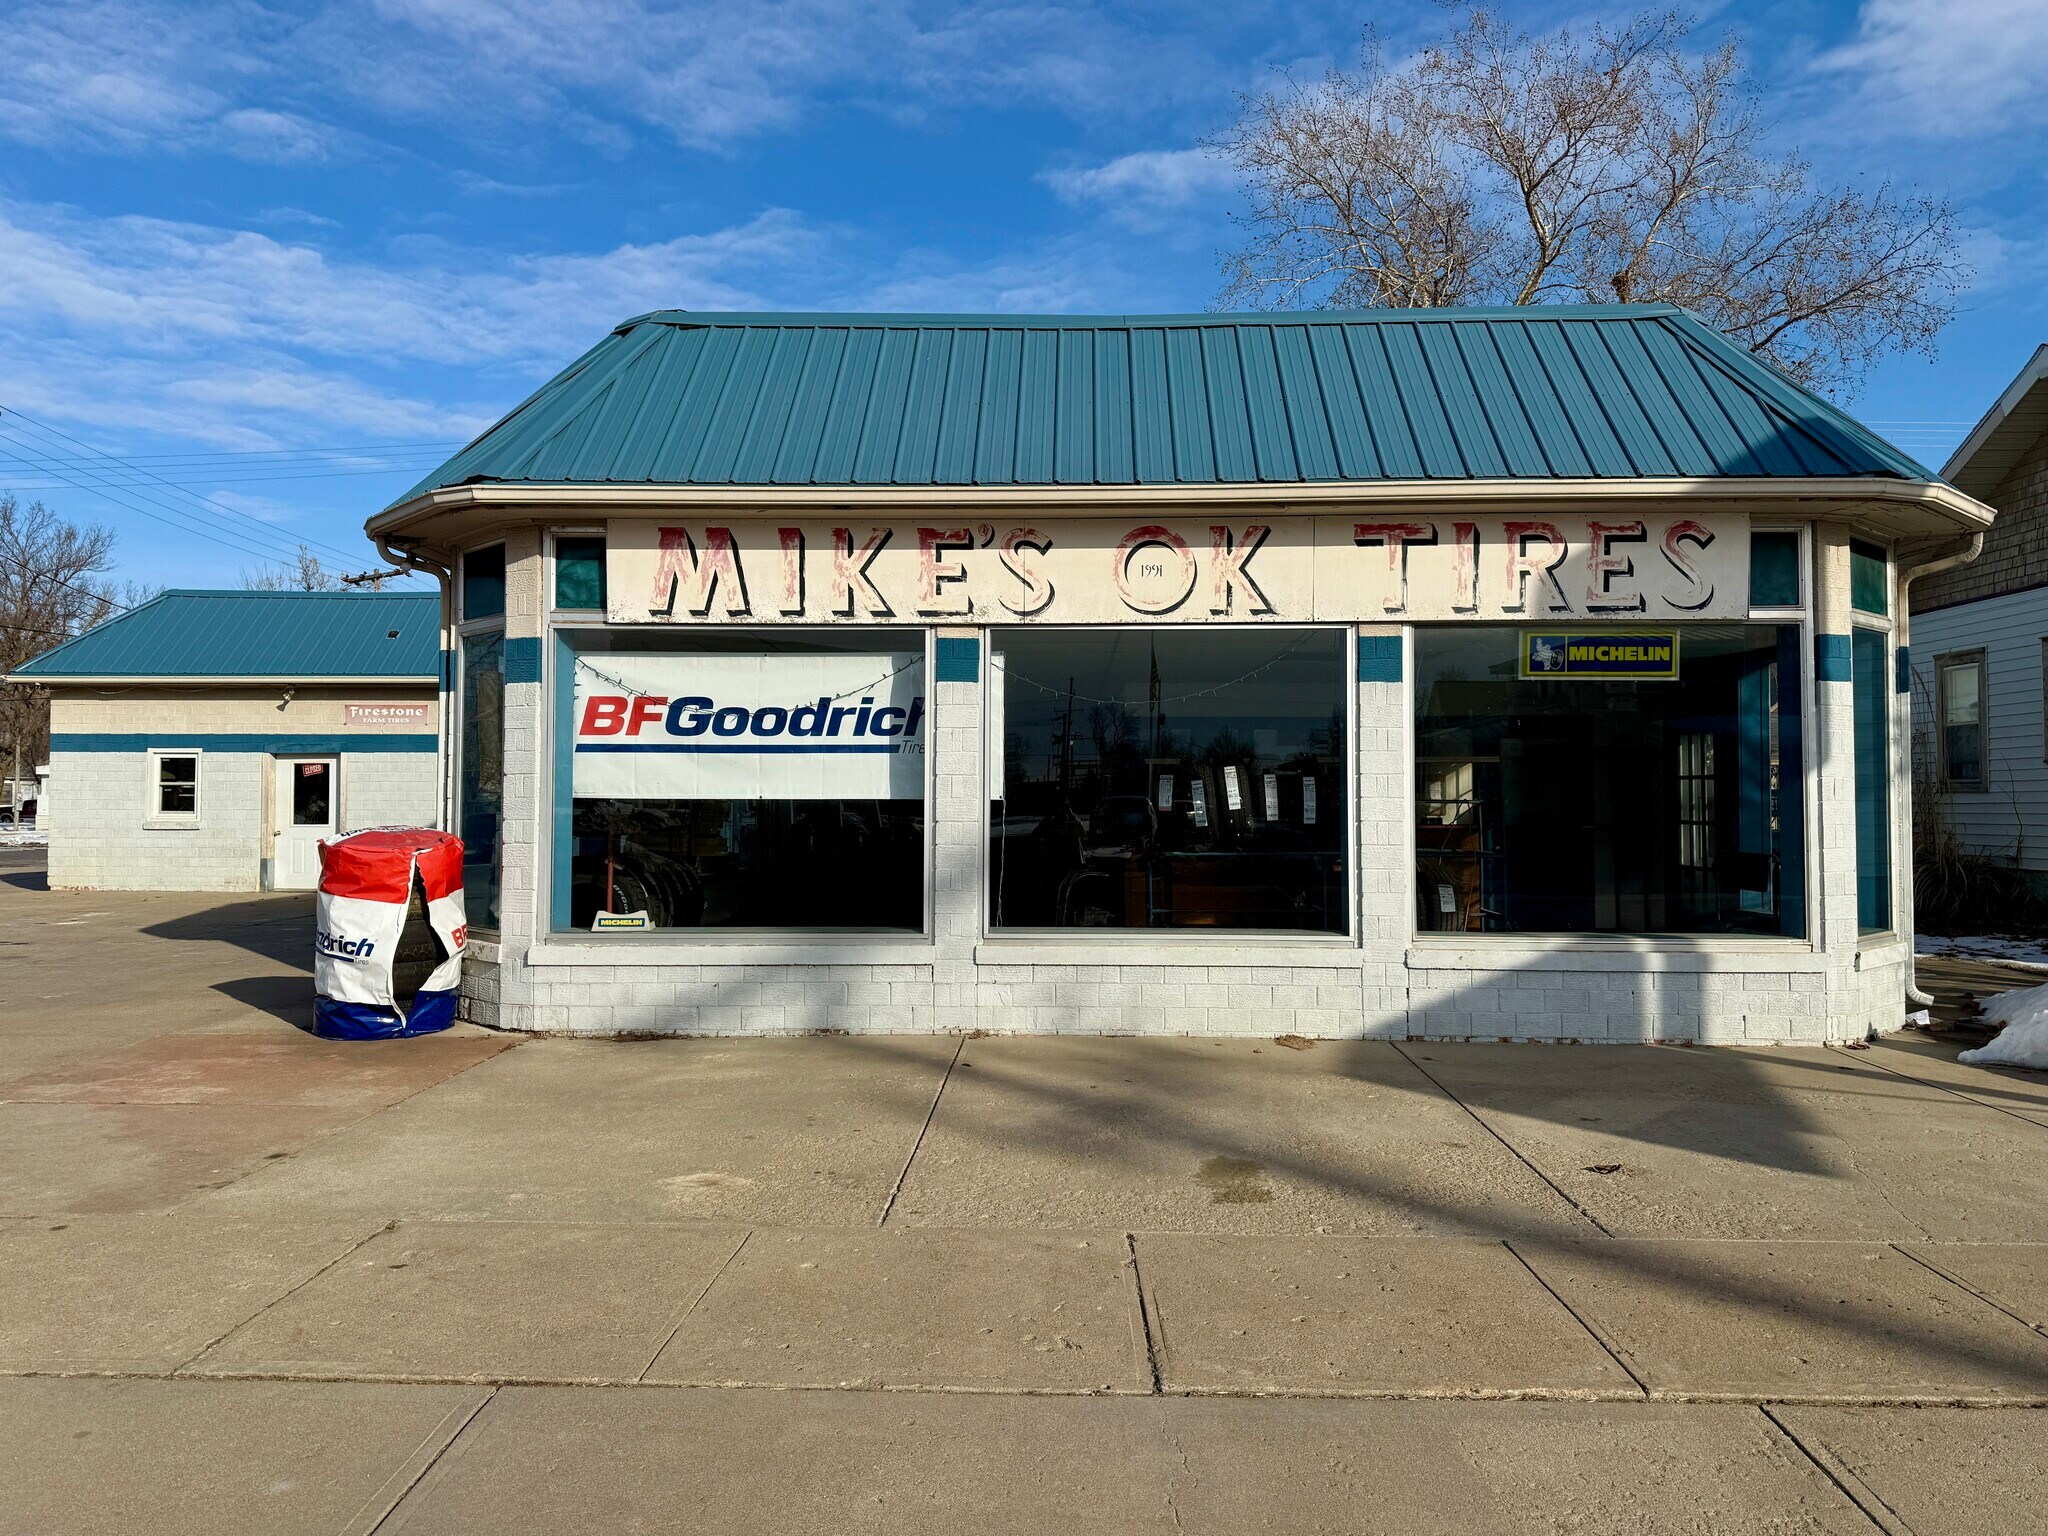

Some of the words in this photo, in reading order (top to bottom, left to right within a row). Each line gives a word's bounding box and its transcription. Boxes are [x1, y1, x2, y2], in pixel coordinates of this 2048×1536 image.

[648, 523, 1056, 617] MIKE'S
[1113, 524, 1279, 615] OK
[1353, 520, 1717, 613] TIRES
[1141, 564, 1163, 578] 1991
[1568, 646, 1671, 661] MICHELIN
[349, 705, 424, 718] Firestone
[304, 764, 323, 775] CLOSED
